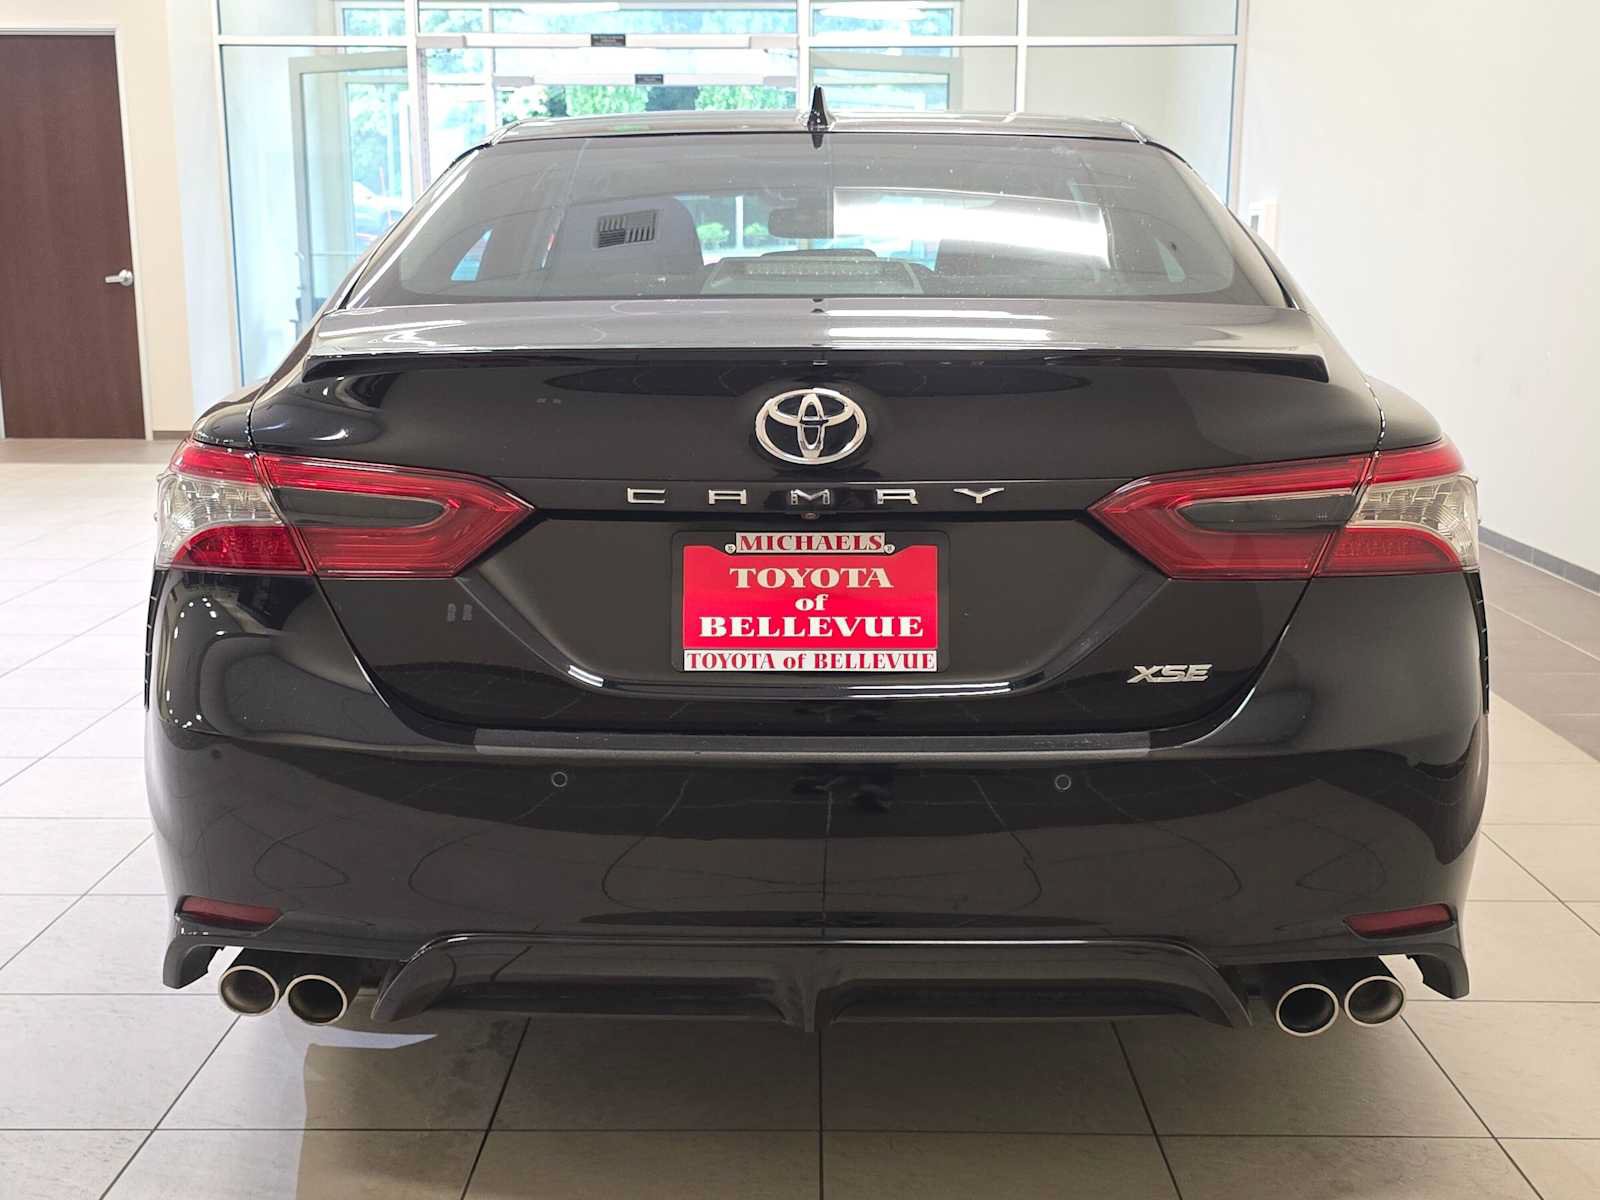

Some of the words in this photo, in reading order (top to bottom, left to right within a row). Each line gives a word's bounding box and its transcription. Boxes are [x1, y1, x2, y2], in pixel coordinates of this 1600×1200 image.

[626, 487, 1005, 505] CAMRY
[740, 535, 882, 551] MICHAELS
[729, 567, 894, 589] TOYOTA
[794, 593, 829, 612] of
[698, 616, 923, 638] BELLEVUE
[687, 653, 776, 669] TOYOTA
[783, 653, 807, 669] of
[814, 653, 936, 669] BELLEVUE
[1127, 664, 1213, 683] XSE
